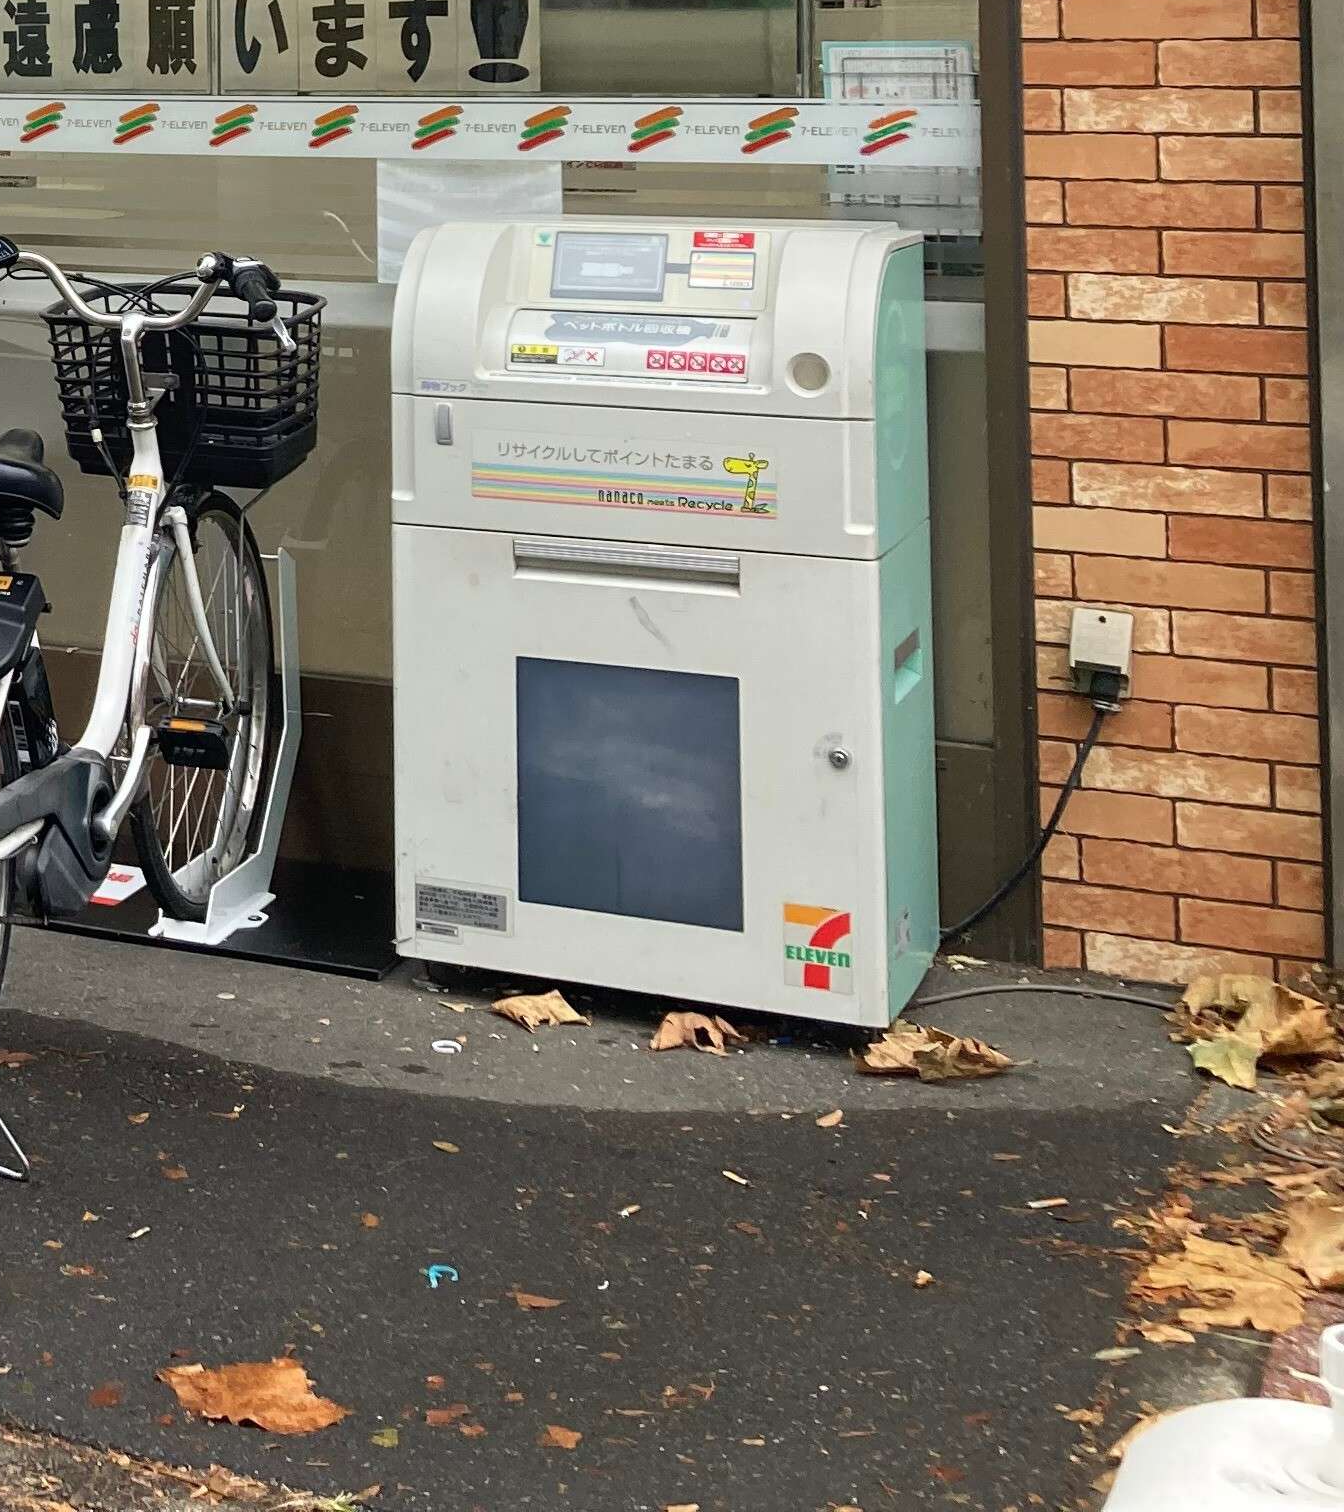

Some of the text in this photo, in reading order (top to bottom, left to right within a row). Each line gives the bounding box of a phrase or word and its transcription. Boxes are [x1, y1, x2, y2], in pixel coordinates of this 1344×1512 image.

[498, 441, 714, 471] リサイクルしてポイントたまる
[598, 488, 644, 506] nanaco
[677, 496, 733, 513] Recycle
